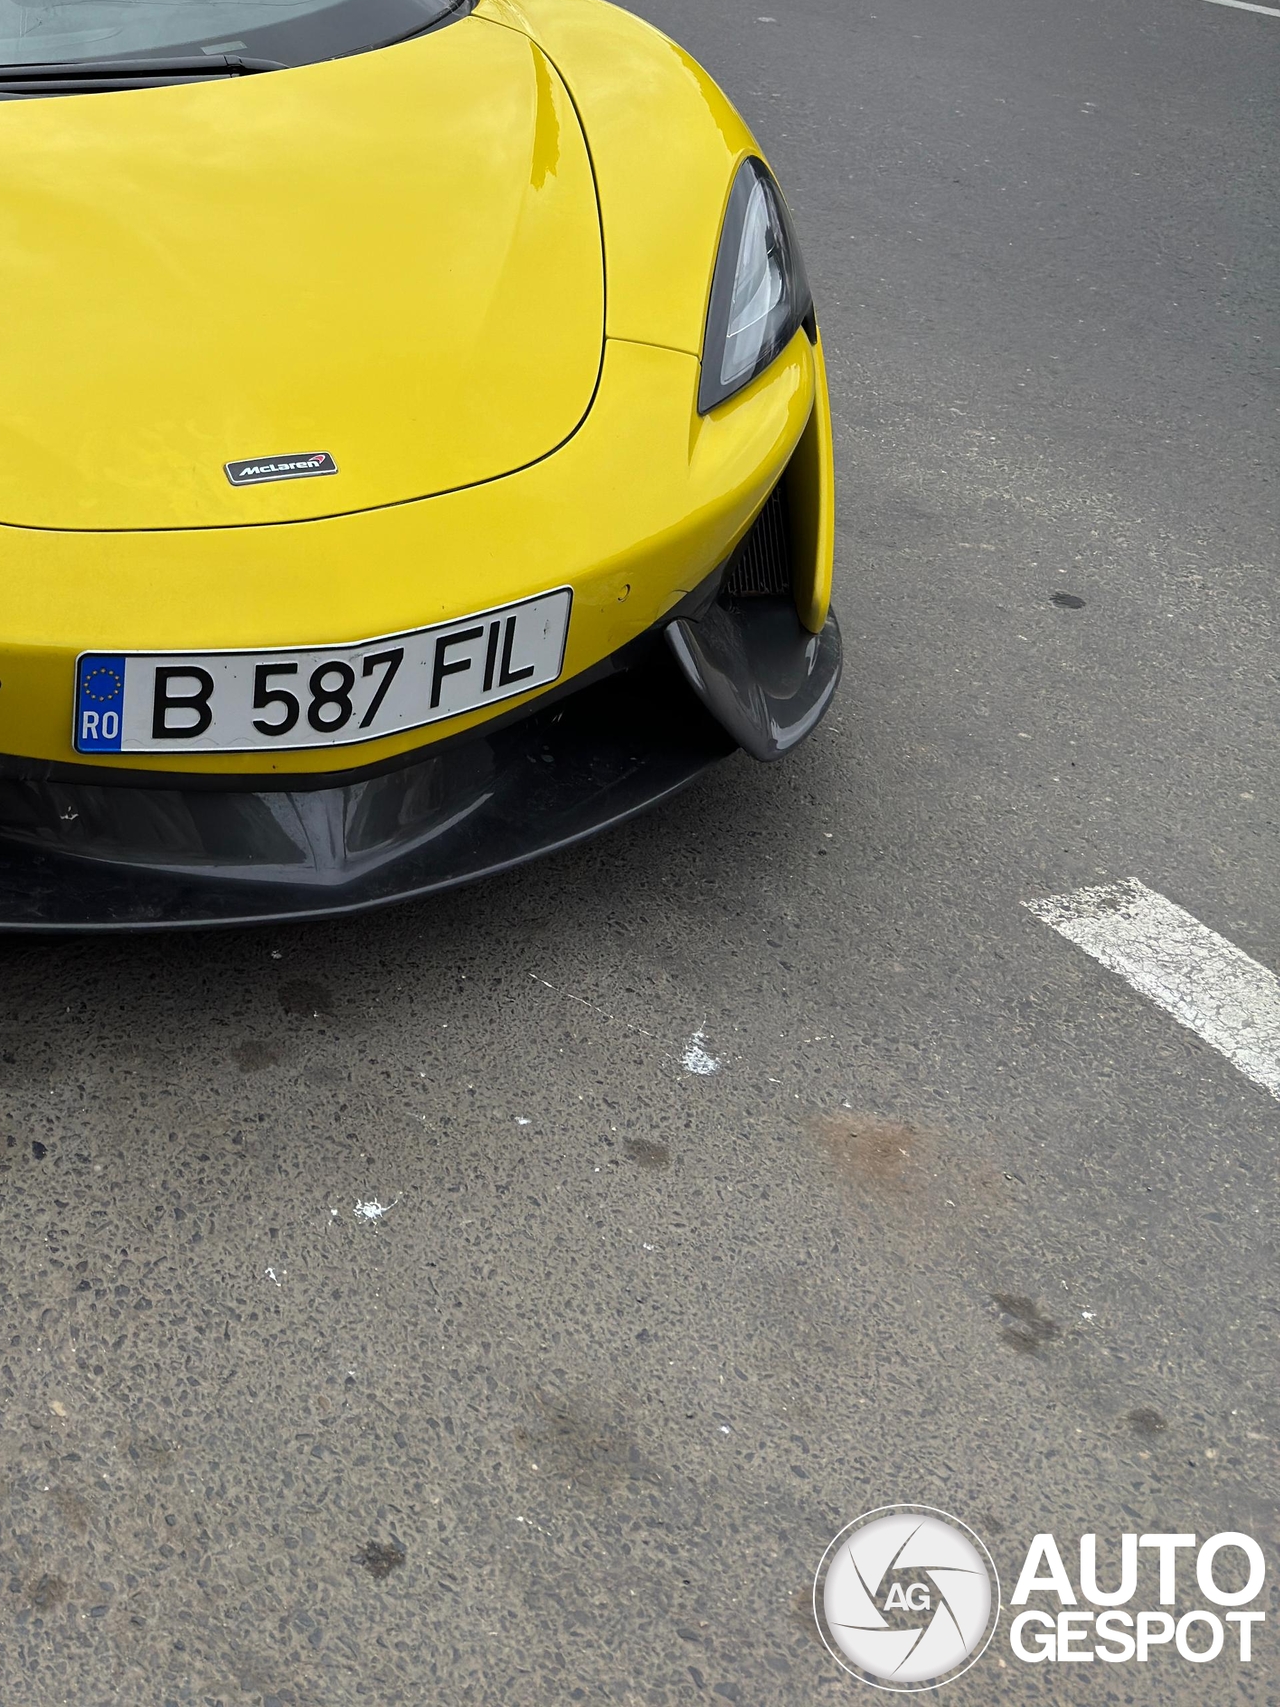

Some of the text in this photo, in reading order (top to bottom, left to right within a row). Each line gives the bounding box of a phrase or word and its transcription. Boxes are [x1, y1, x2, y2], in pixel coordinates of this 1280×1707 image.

[239, 460, 320, 477] McLaren
[152, 615, 535, 739] B 587 FIL
[82, 711, 119, 739] RO
